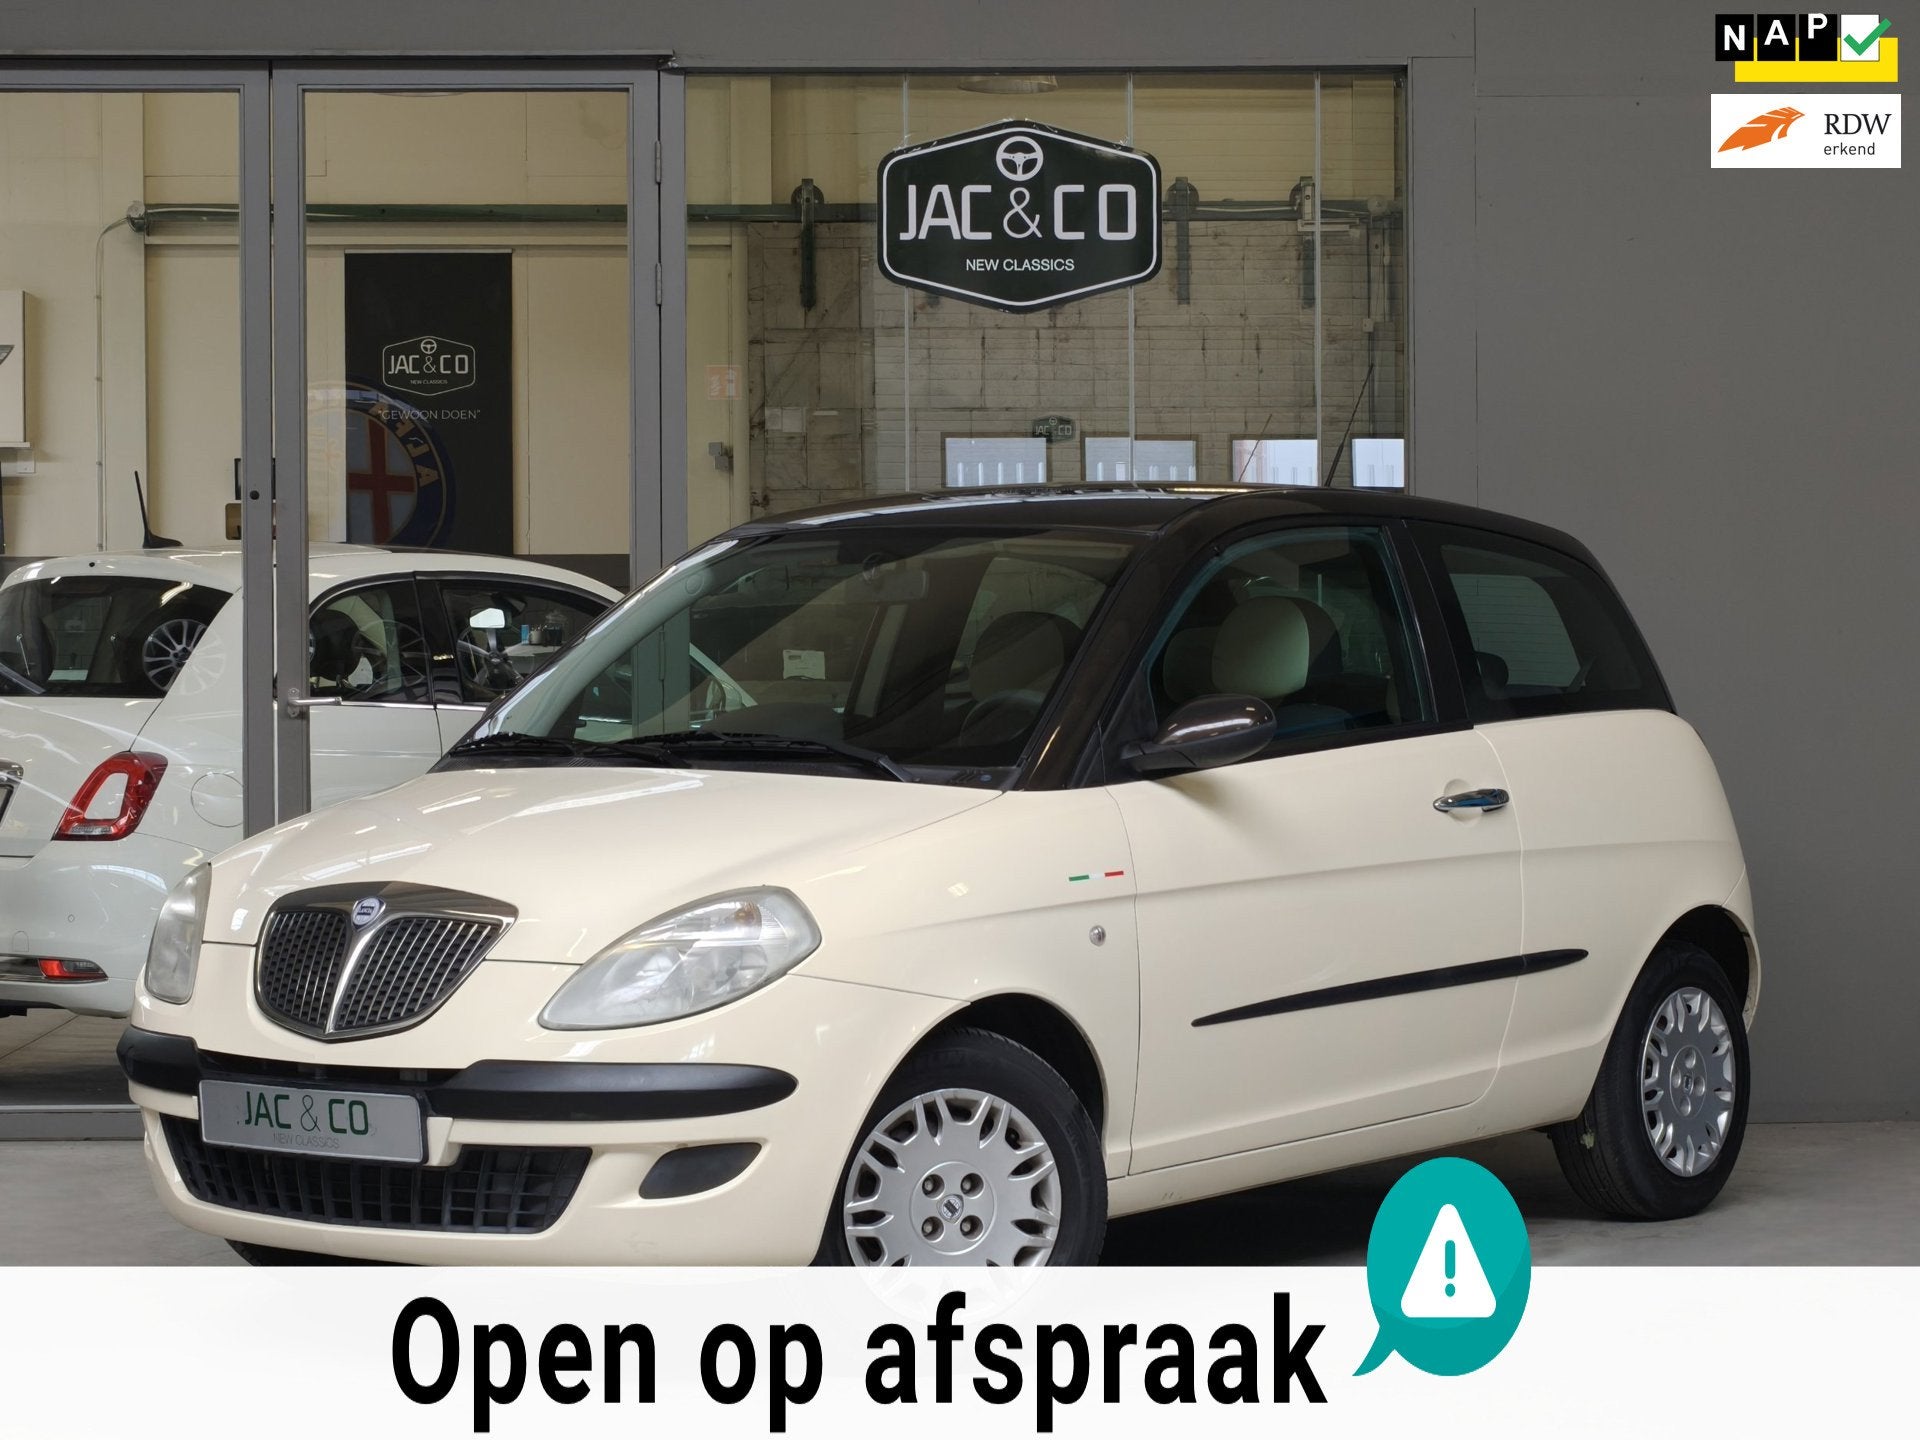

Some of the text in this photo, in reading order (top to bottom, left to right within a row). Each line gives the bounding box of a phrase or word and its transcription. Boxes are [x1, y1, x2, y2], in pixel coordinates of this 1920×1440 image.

[900, 184, 1137, 241] JAC & CO
[966, 258, 1075, 271] NEW CLASSICS
[388, 354, 469, 374] JAC & CO
[244, 1091, 369, 1136] JAC & CO
[273, 1133, 340, 1149] NEW CLASSICS
